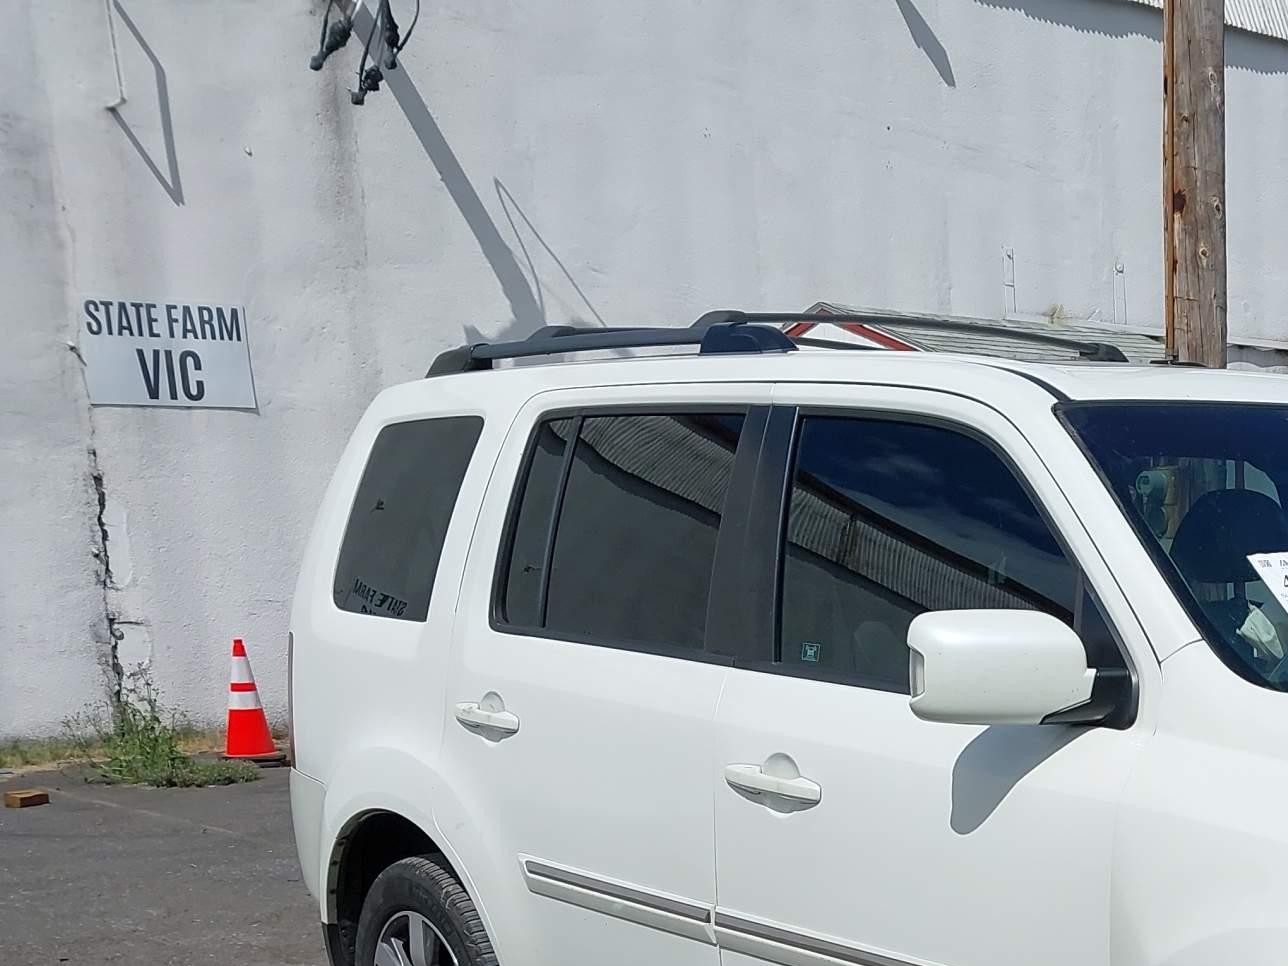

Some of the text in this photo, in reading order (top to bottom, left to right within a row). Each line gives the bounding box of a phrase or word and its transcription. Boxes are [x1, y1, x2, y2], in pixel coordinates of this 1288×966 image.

[84, 300, 242, 342] STATE FARM
[135, 348, 205, 401] VIC
